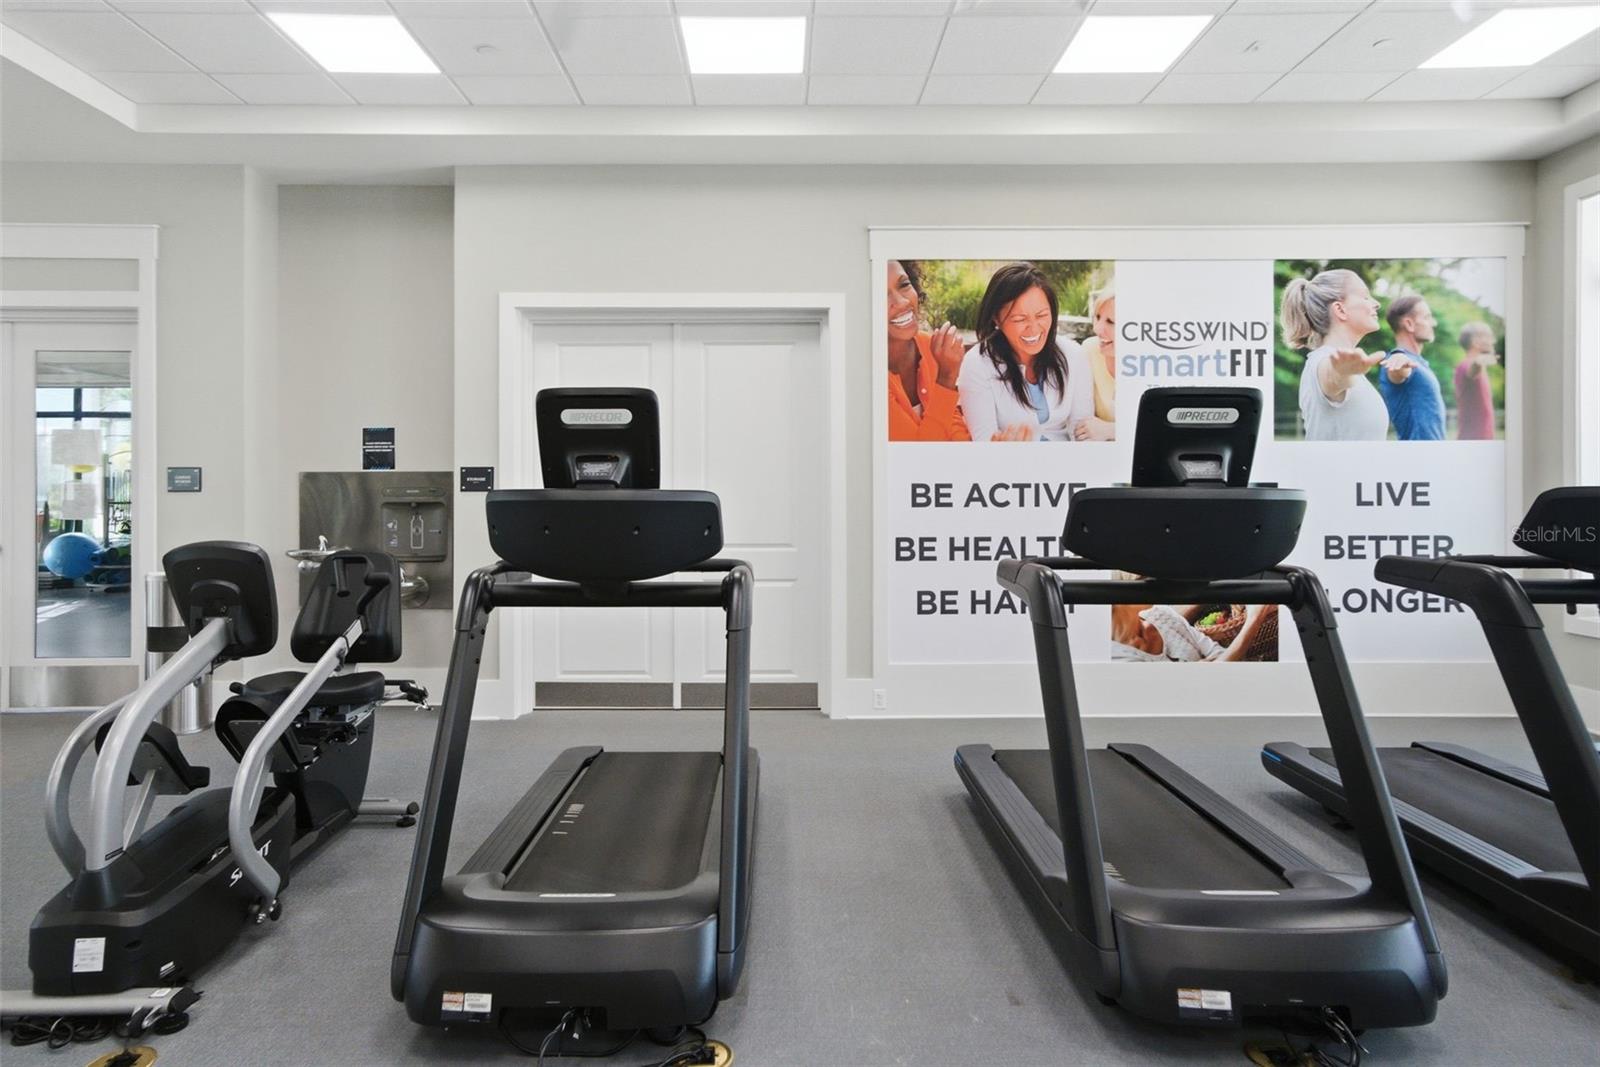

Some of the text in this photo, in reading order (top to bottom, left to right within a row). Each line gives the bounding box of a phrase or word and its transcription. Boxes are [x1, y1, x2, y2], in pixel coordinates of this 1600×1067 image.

[1121, 349, 1268, 377] smartFIT
[576, 412, 623, 422] PRECOR
[1182, 411, 1230, 421] PRECOR
[911, 483, 954, 508] BE
[1356, 482, 1431, 507] LIVE
[895, 536, 1077, 561] BE HEALT
[917, 590, 959, 615] BE
